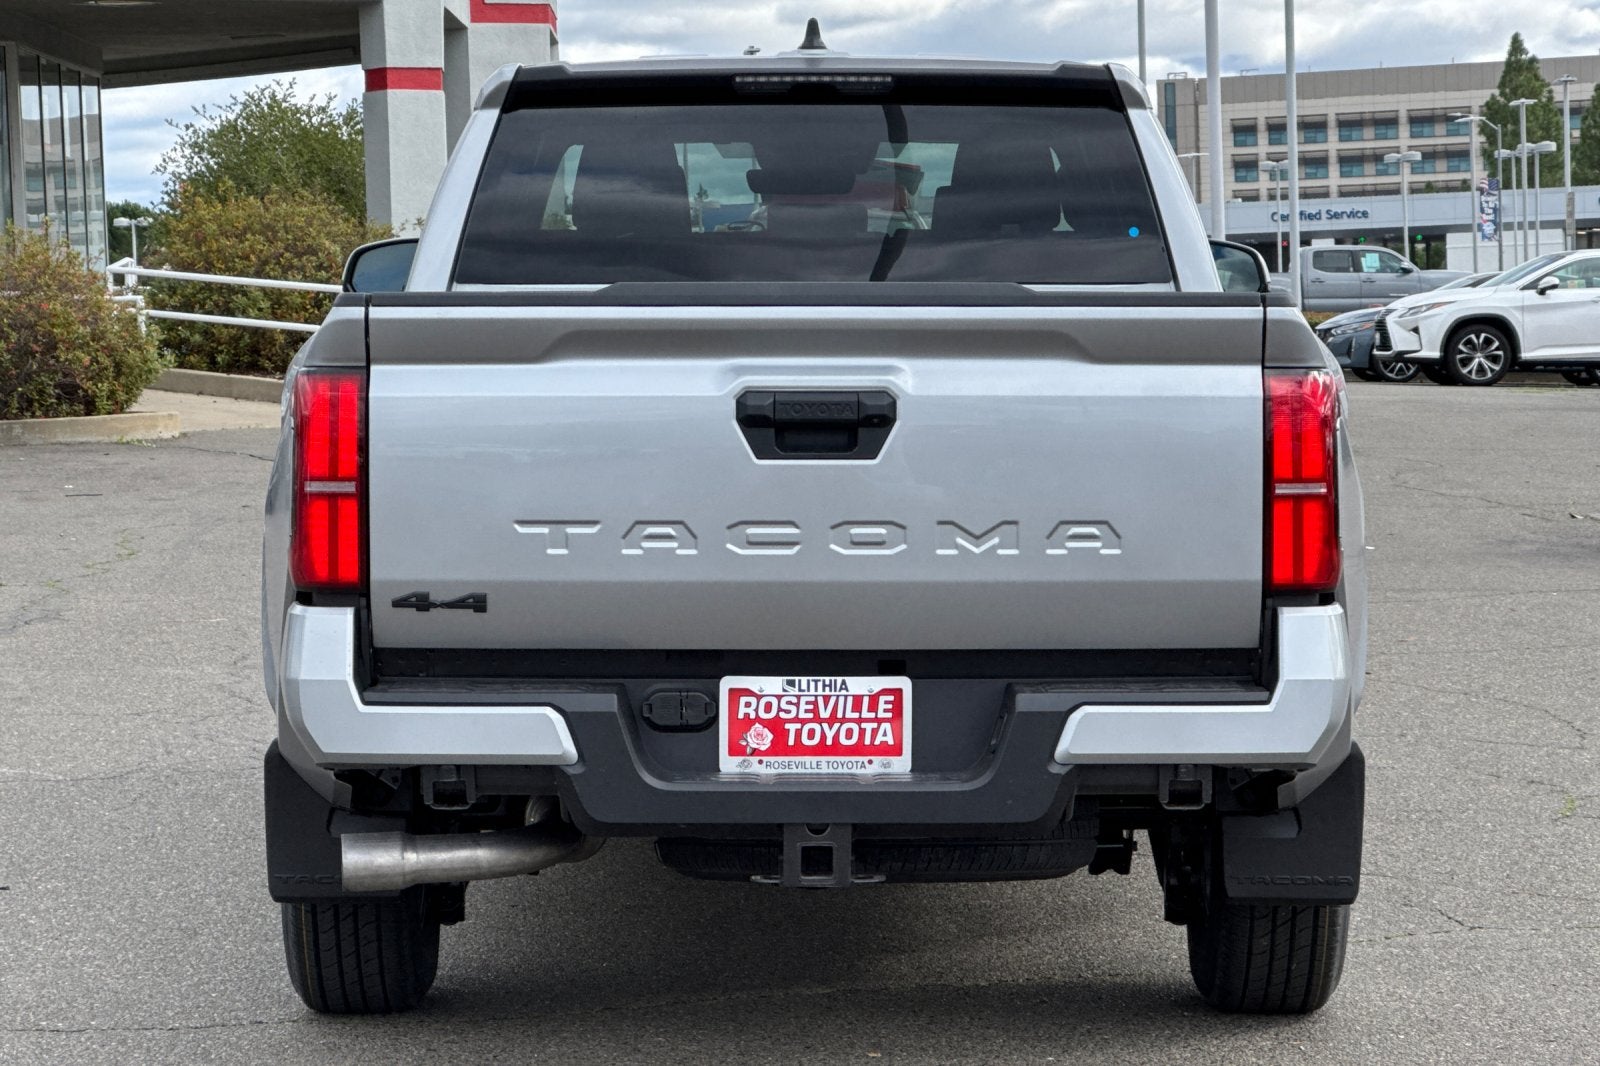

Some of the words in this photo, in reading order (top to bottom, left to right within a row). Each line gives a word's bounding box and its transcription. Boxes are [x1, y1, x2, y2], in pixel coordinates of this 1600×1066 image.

[1271, 209, 1322, 222] Cerfied
[1325, 208, 1369, 220] Service
[779, 402, 854, 417] TOYOTA
[513, 519, 1122, 556] TACOMA
[798, 679, 849, 692] LITHIA
[737, 695, 895, 720] ROSEVILLE
[784, 722, 895, 747] TOYOTA
[765, 760, 823, 770] ROSEVILLE
[826, 760, 867, 770] TOYOTA
[273, 873, 342, 885] TAC
[1230, 875, 1354, 887] TACOMA
